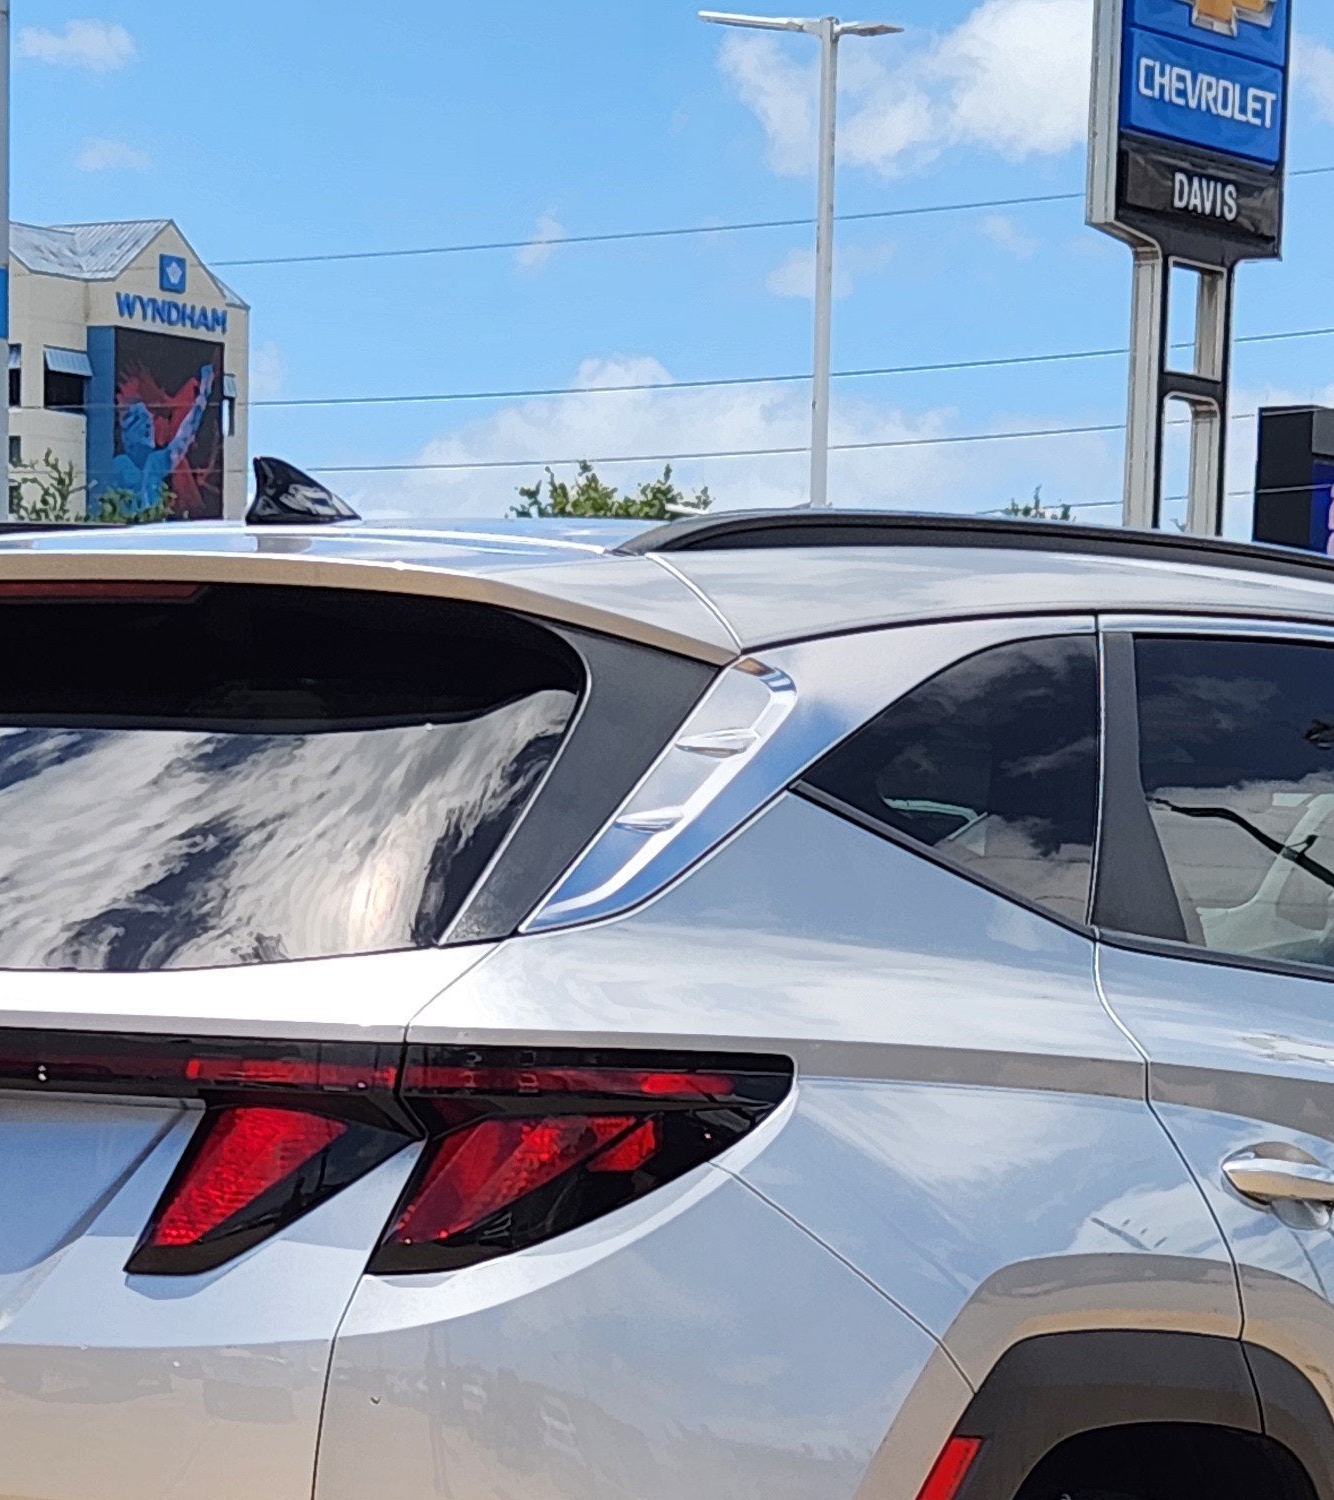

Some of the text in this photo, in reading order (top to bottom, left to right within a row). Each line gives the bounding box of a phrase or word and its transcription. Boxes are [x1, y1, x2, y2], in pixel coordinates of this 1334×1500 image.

[1138, 57, 1276, 129] CHEVROLET
[1173, 171, 1237, 222] DAVIS
[116, 291, 227, 335] WYNDHAM
